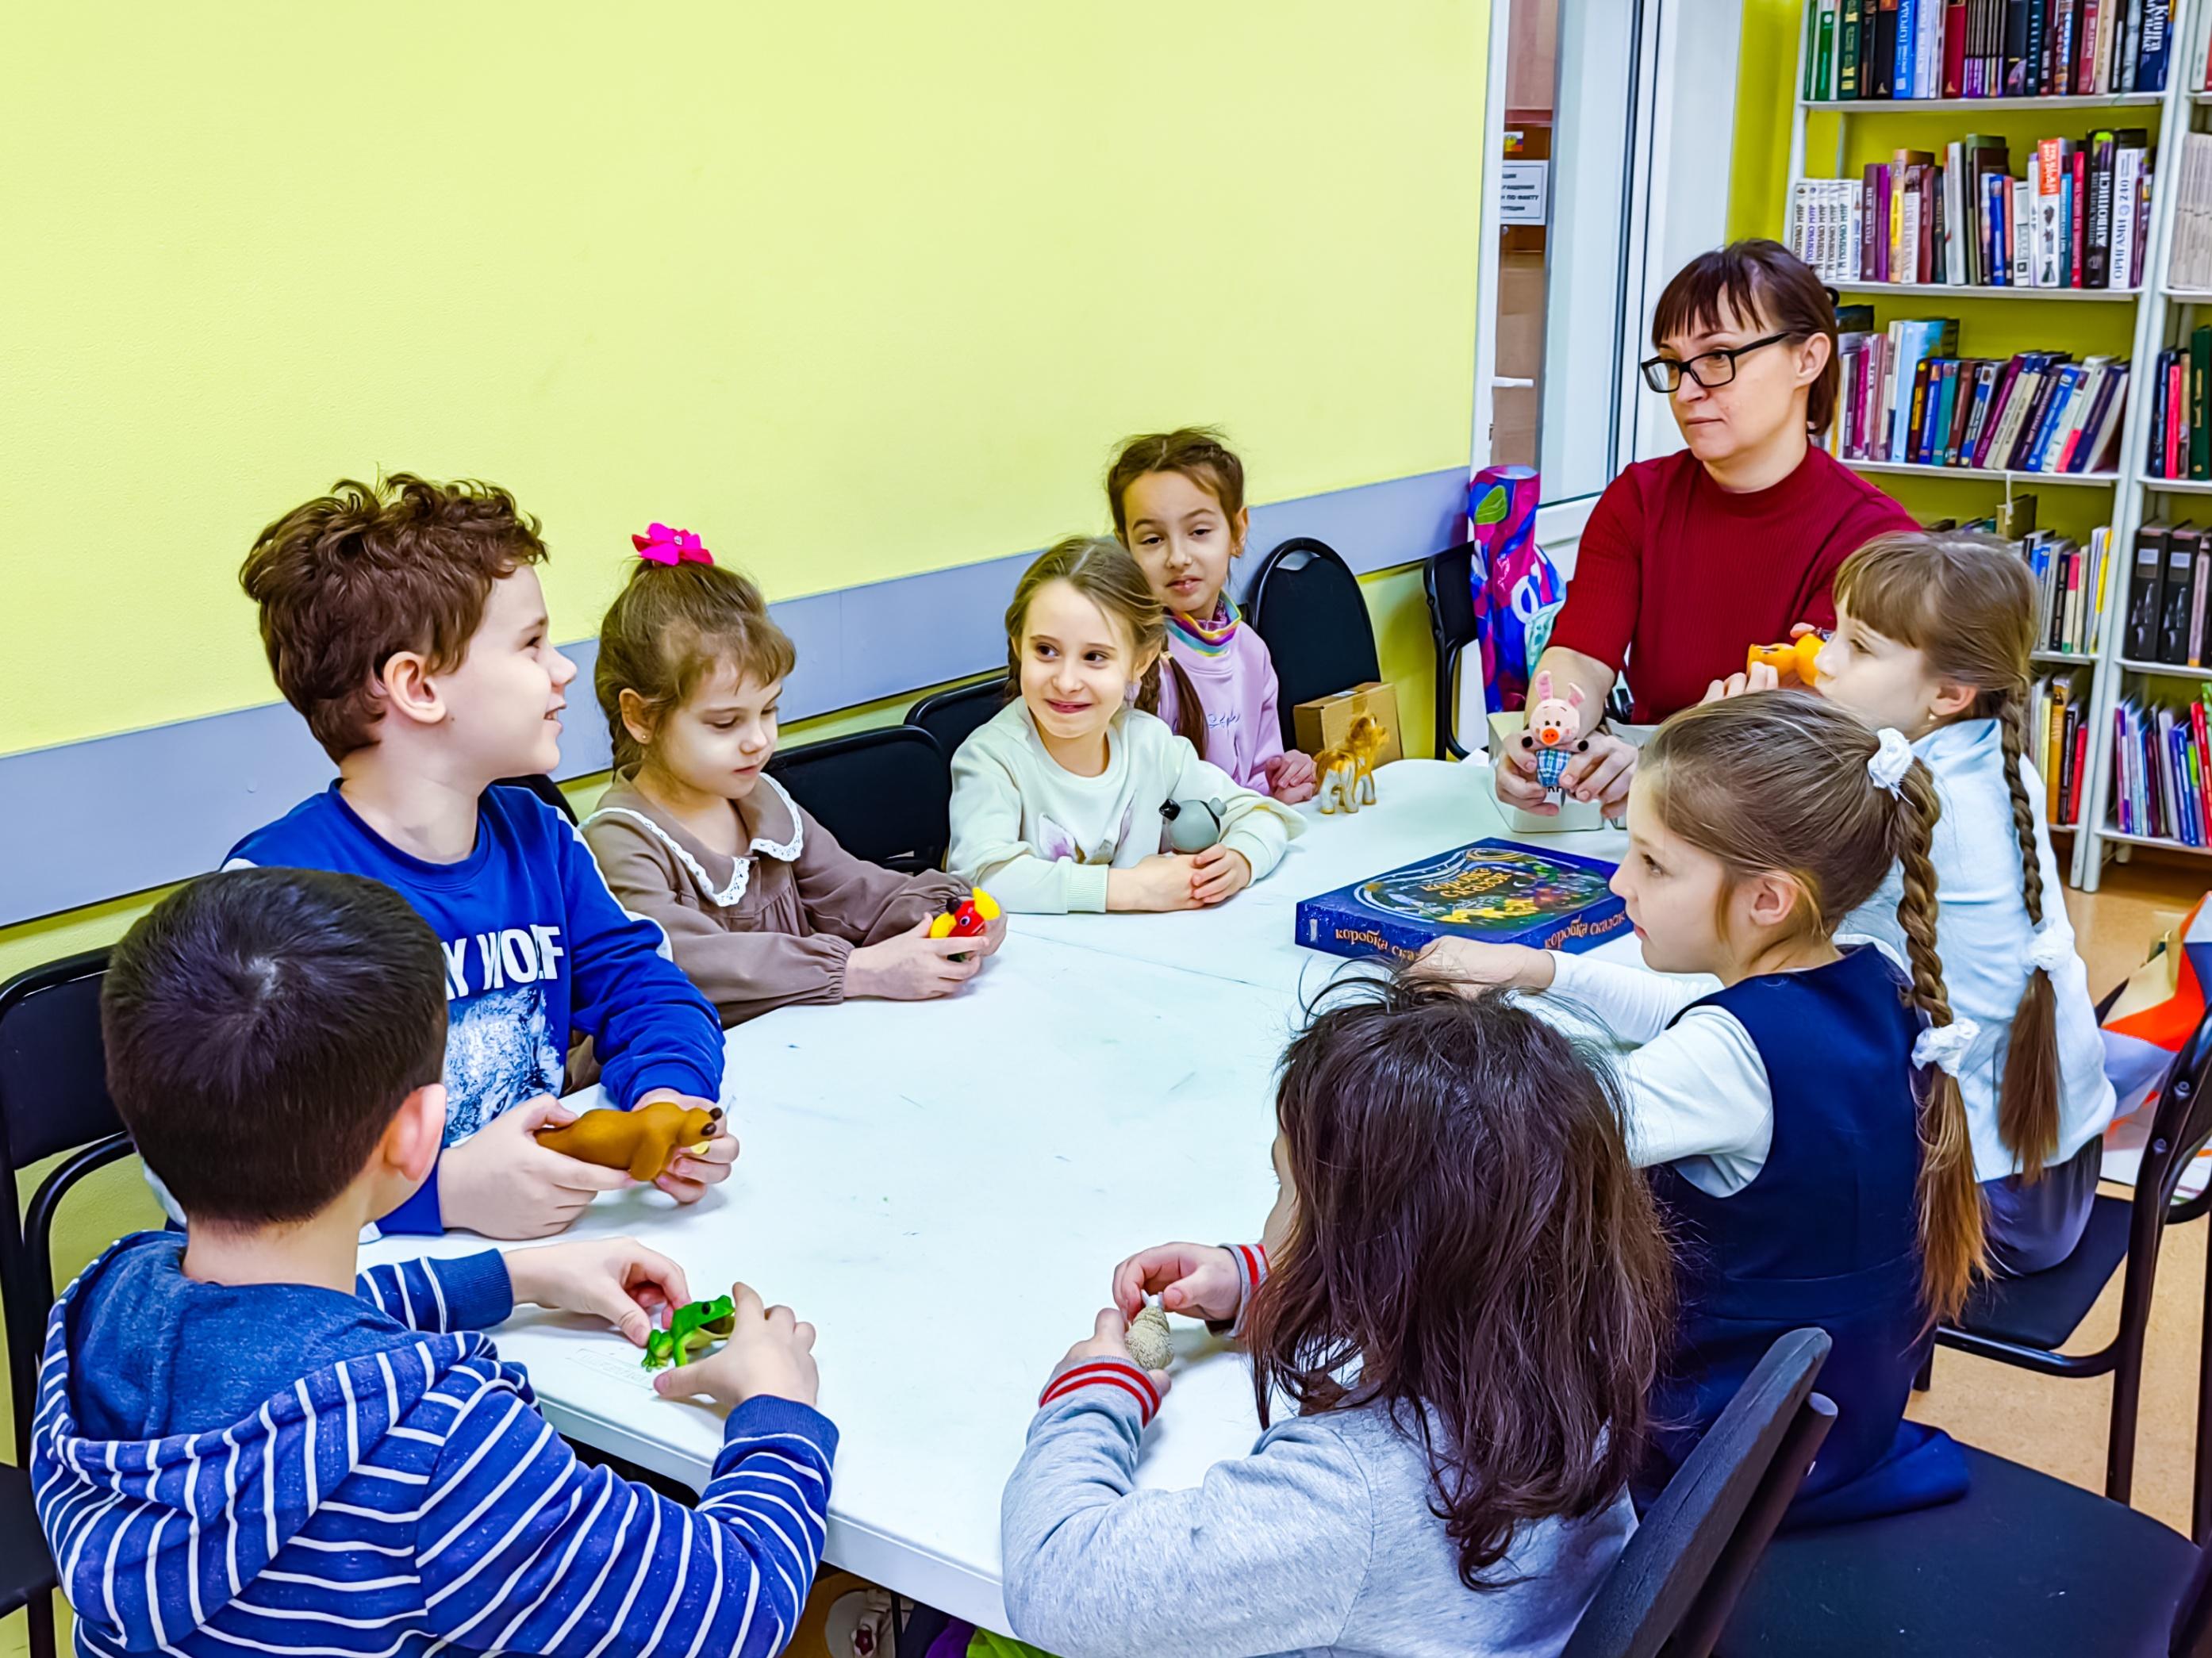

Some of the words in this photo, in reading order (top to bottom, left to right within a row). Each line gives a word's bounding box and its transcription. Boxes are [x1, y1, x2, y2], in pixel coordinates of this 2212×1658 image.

[2095, 171, 2111, 248] ЖИВОПИСИ
[2119, 179, 2129, 201] 240
[2113, 219, 2128, 279] ОРИГАМИ
[1335, 928, 1388, 951] коробка
[1391, 945, 1419, 961] ска
[1545, 914, 1588, 950] коробка
[1590, 911, 1626, 935] сказок
